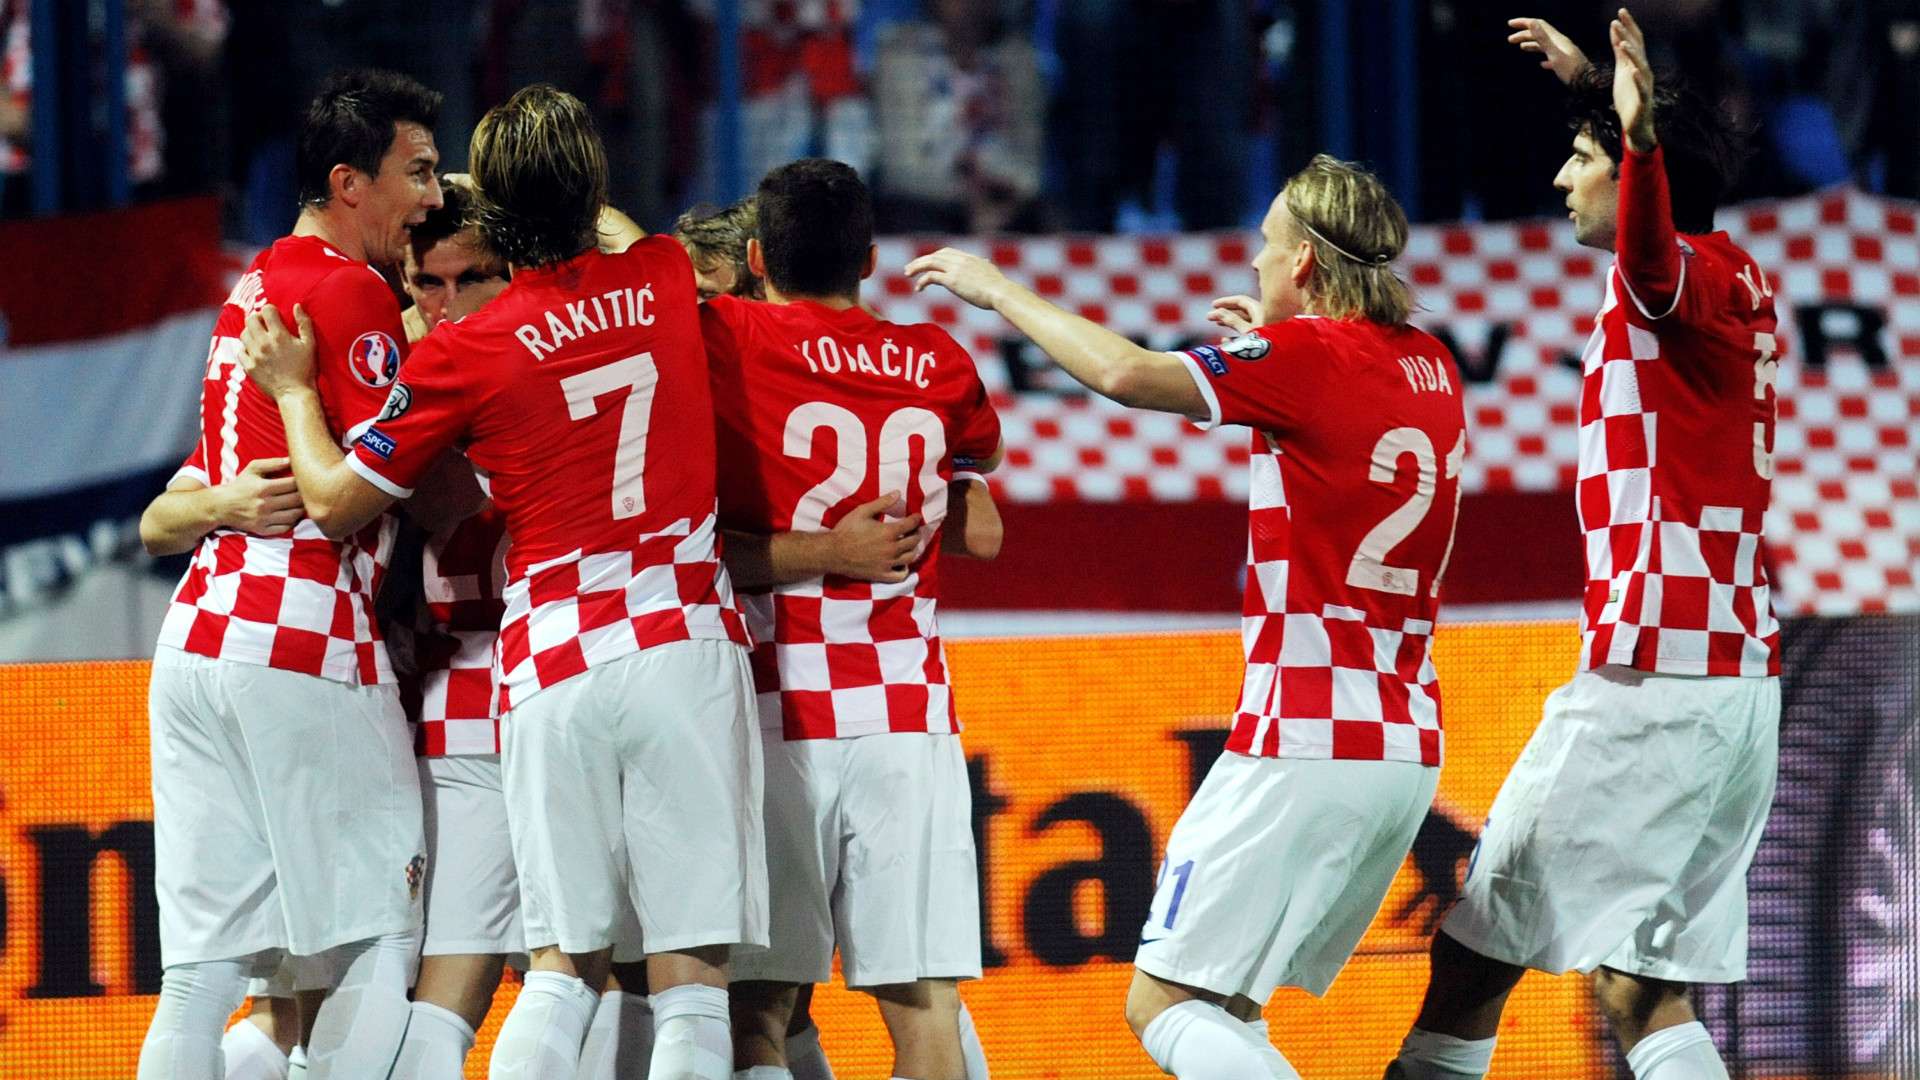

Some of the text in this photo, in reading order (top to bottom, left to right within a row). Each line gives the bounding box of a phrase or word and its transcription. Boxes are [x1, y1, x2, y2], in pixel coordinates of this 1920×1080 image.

[514, 282, 656, 362] RAKITIĆ
[1397, 355, 1454, 396] VIDA
[361, 432, 395, 456] SPECT
[559, 351, 659, 521] 7
[782, 400, 949, 560] 20
[1344, 426, 1467, 599] 21
